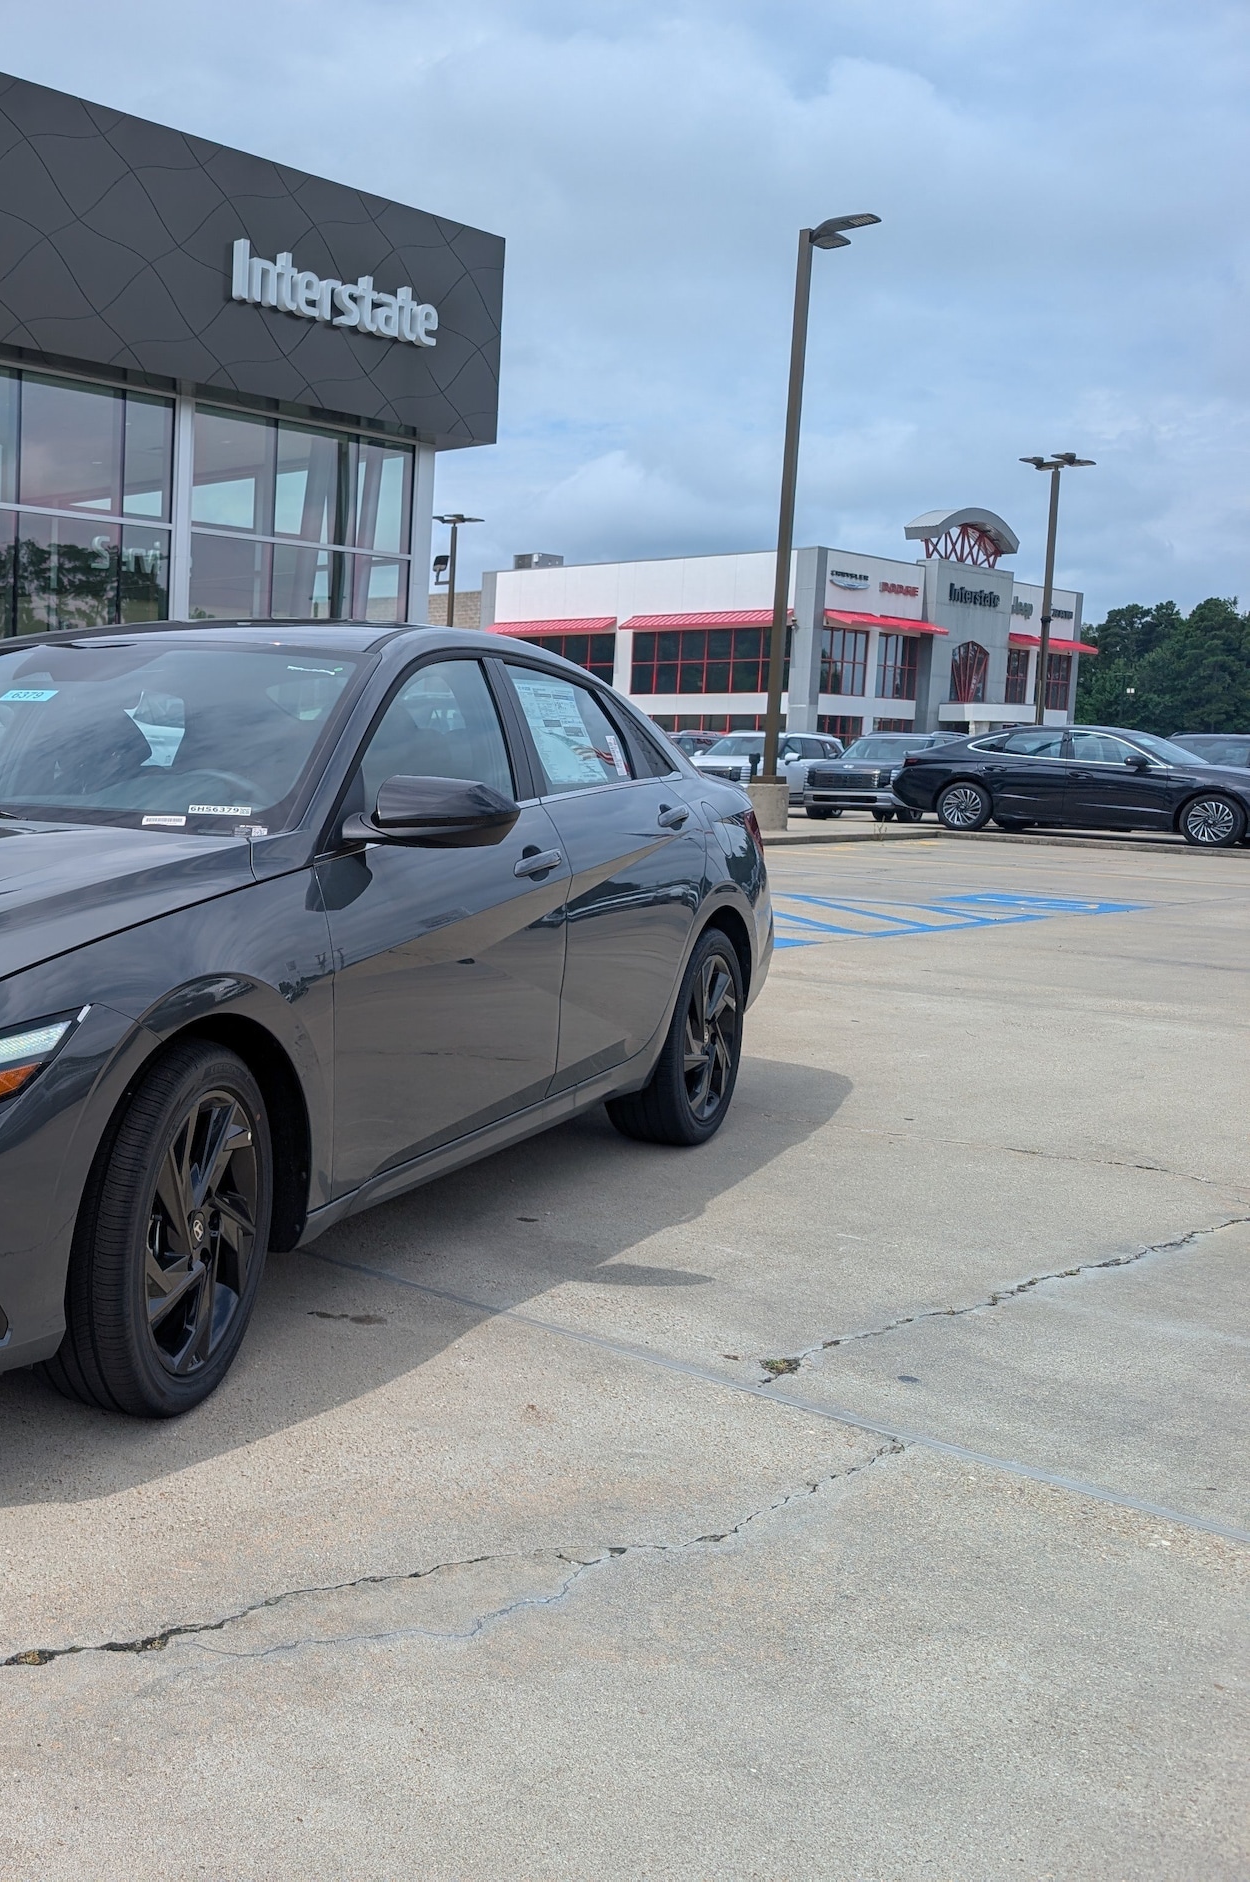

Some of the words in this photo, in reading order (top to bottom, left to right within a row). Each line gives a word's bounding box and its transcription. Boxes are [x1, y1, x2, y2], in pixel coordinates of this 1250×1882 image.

[232, 238, 439, 348] Interstate
[948, 582, 1001, 608] Interstate
[11, 691, 45, 699] 6379
